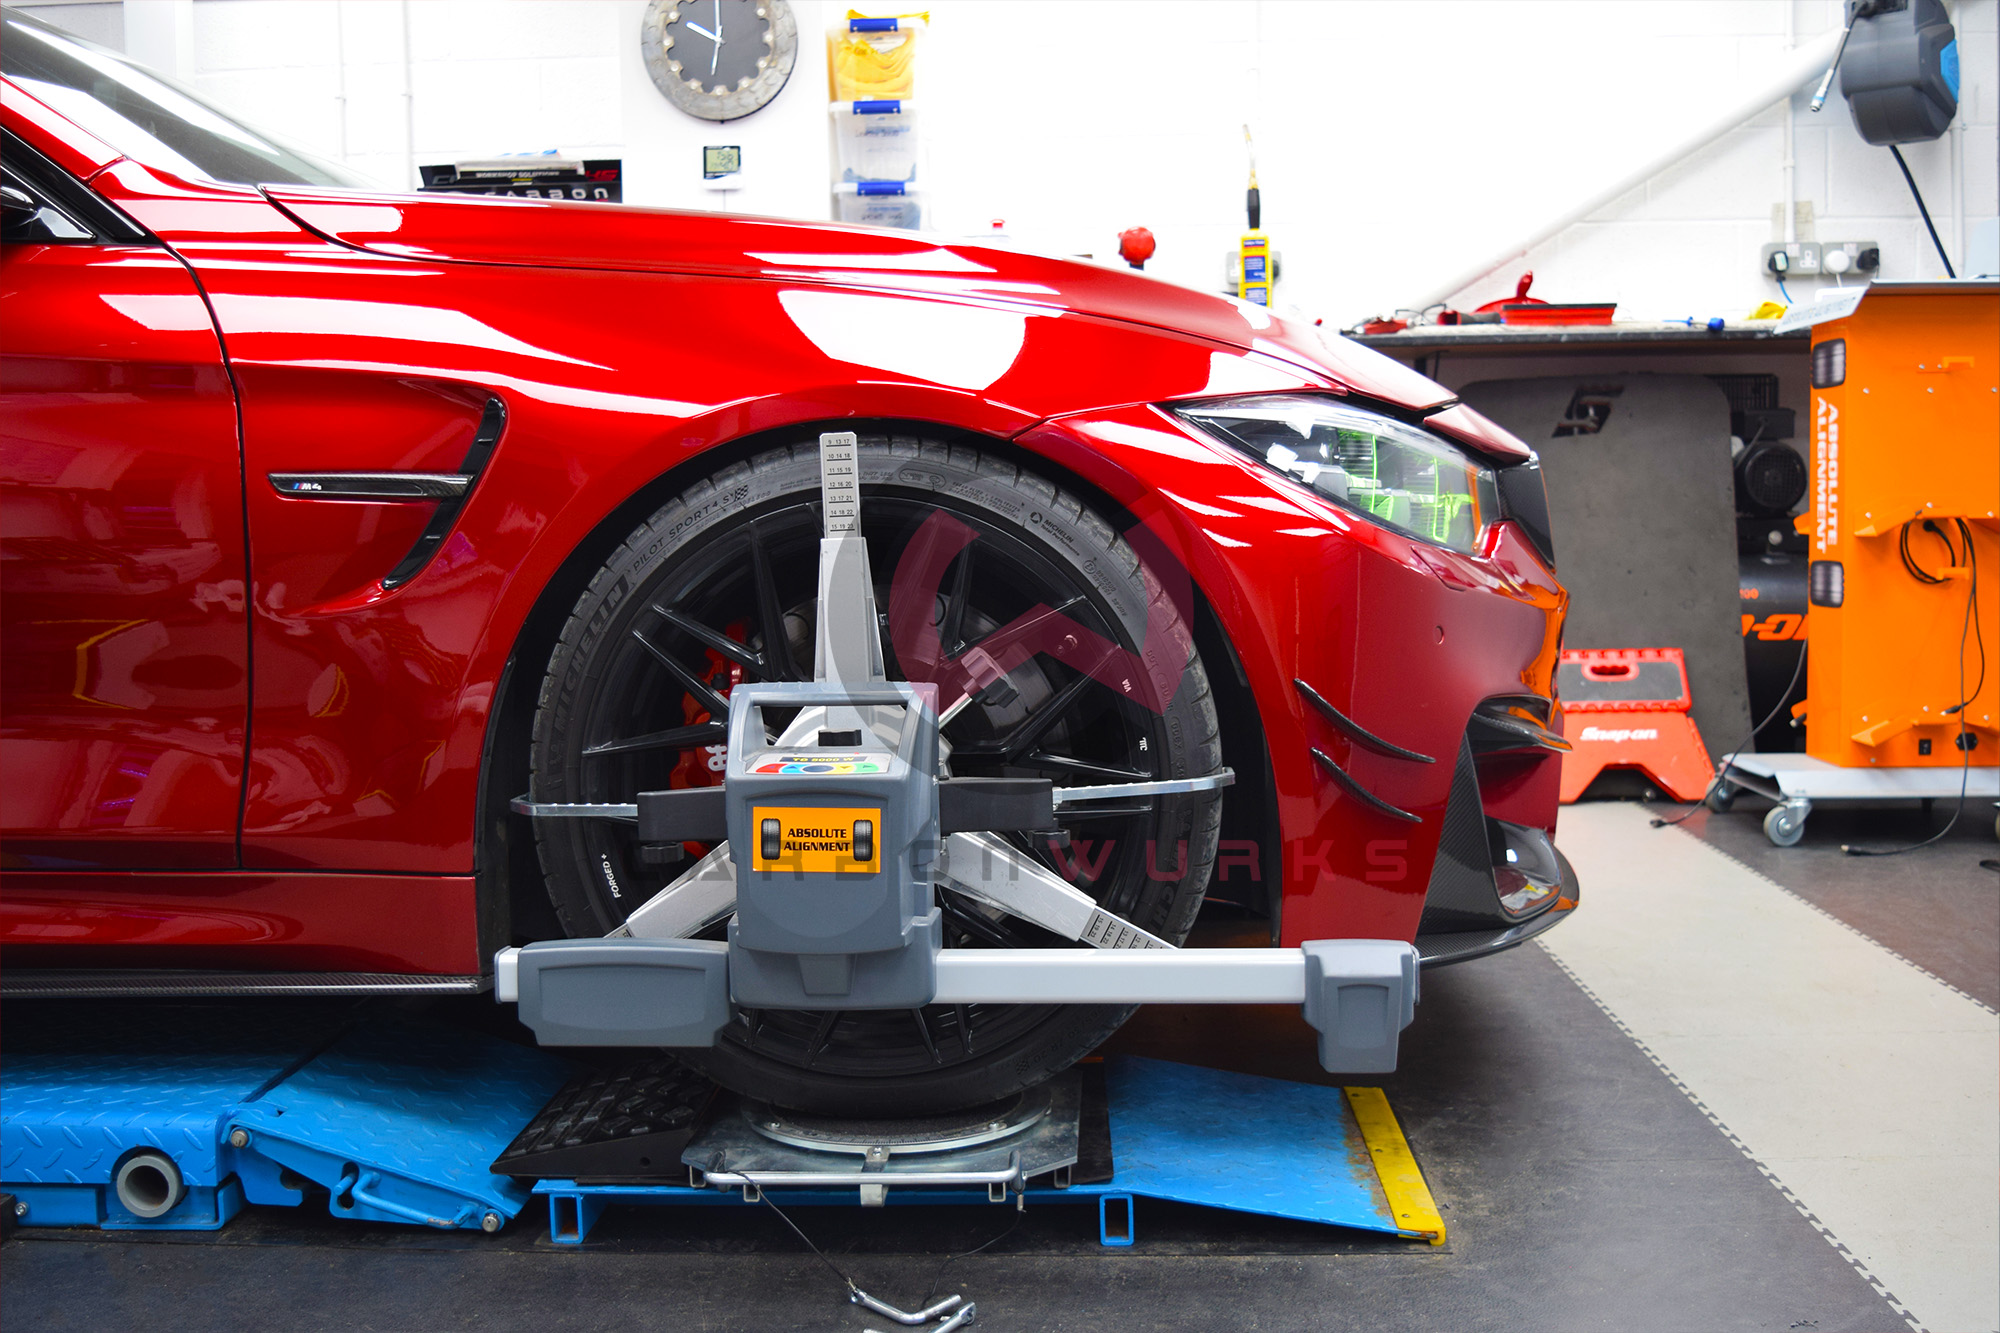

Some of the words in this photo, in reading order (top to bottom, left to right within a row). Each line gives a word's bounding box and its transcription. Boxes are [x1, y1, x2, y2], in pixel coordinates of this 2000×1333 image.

[1816, 396, 1827, 554] ALIGNMENT
[1828, 403, 1838, 545] ABSOLUTE
[300, 482, 322, 491] M4
[632, 536, 664, 571] PILOT
[668, 504, 710, 539] SPORT
[1044, 520, 1074, 544] MICHELIN
[1052, 532, 1080, 556] Performance
[554, 587, 624, 732] MICHELIN
[1580, 726, 1658, 743] Snap-on
[787, 828, 847, 838] ABSOLUTE
[784, 842, 850, 852] ALIGNMENT
[602, 861, 622, 898] FORGED
